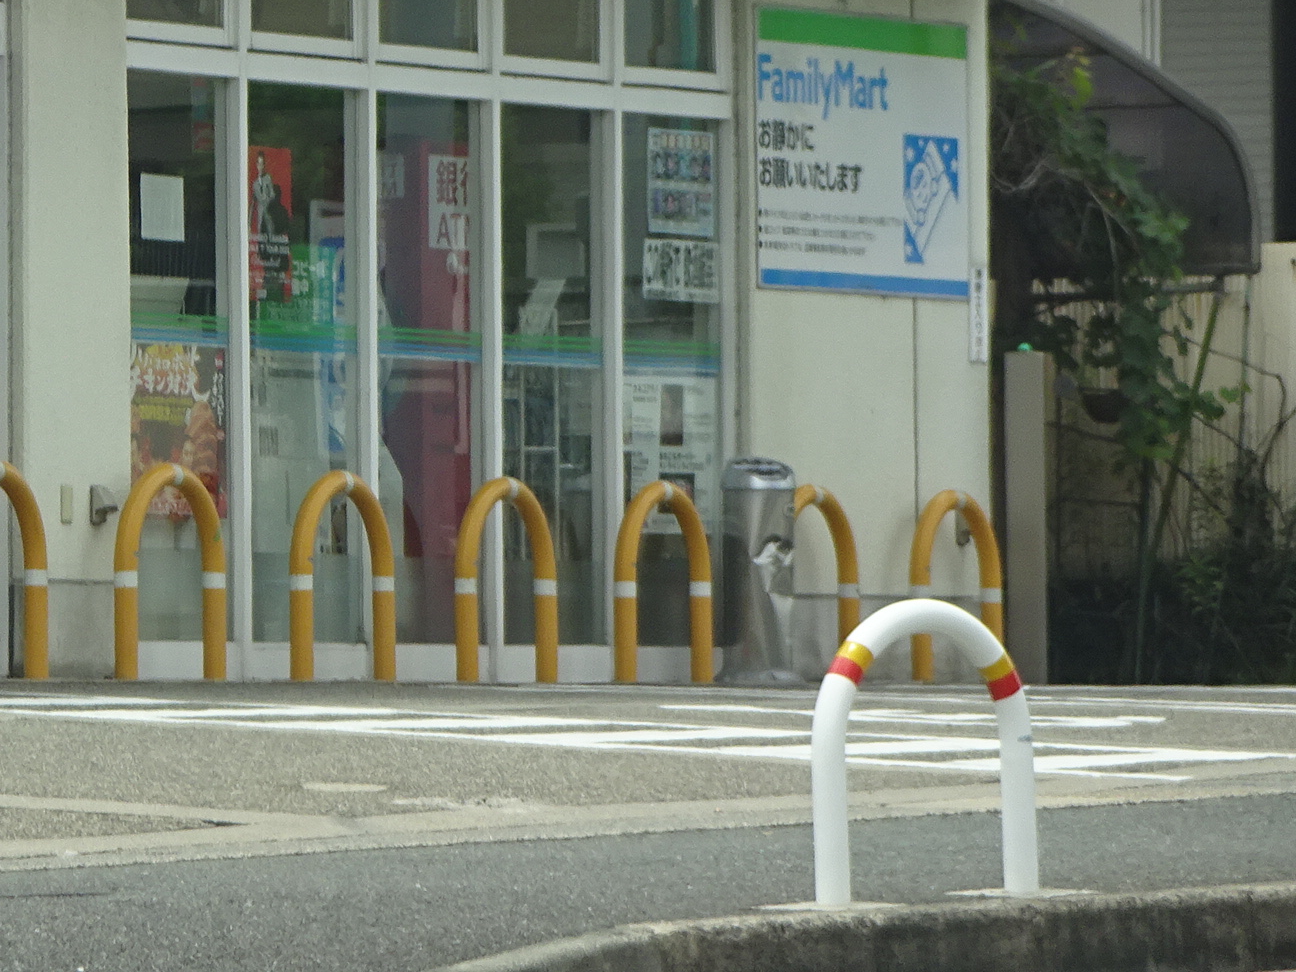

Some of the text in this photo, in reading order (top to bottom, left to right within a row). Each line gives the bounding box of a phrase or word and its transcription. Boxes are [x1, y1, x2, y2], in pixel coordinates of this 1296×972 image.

[756, 53, 889, 120] FamilyMart
[758, 119, 815, 152] お静かに
[759, 156, 862, 193] お願いいたします
